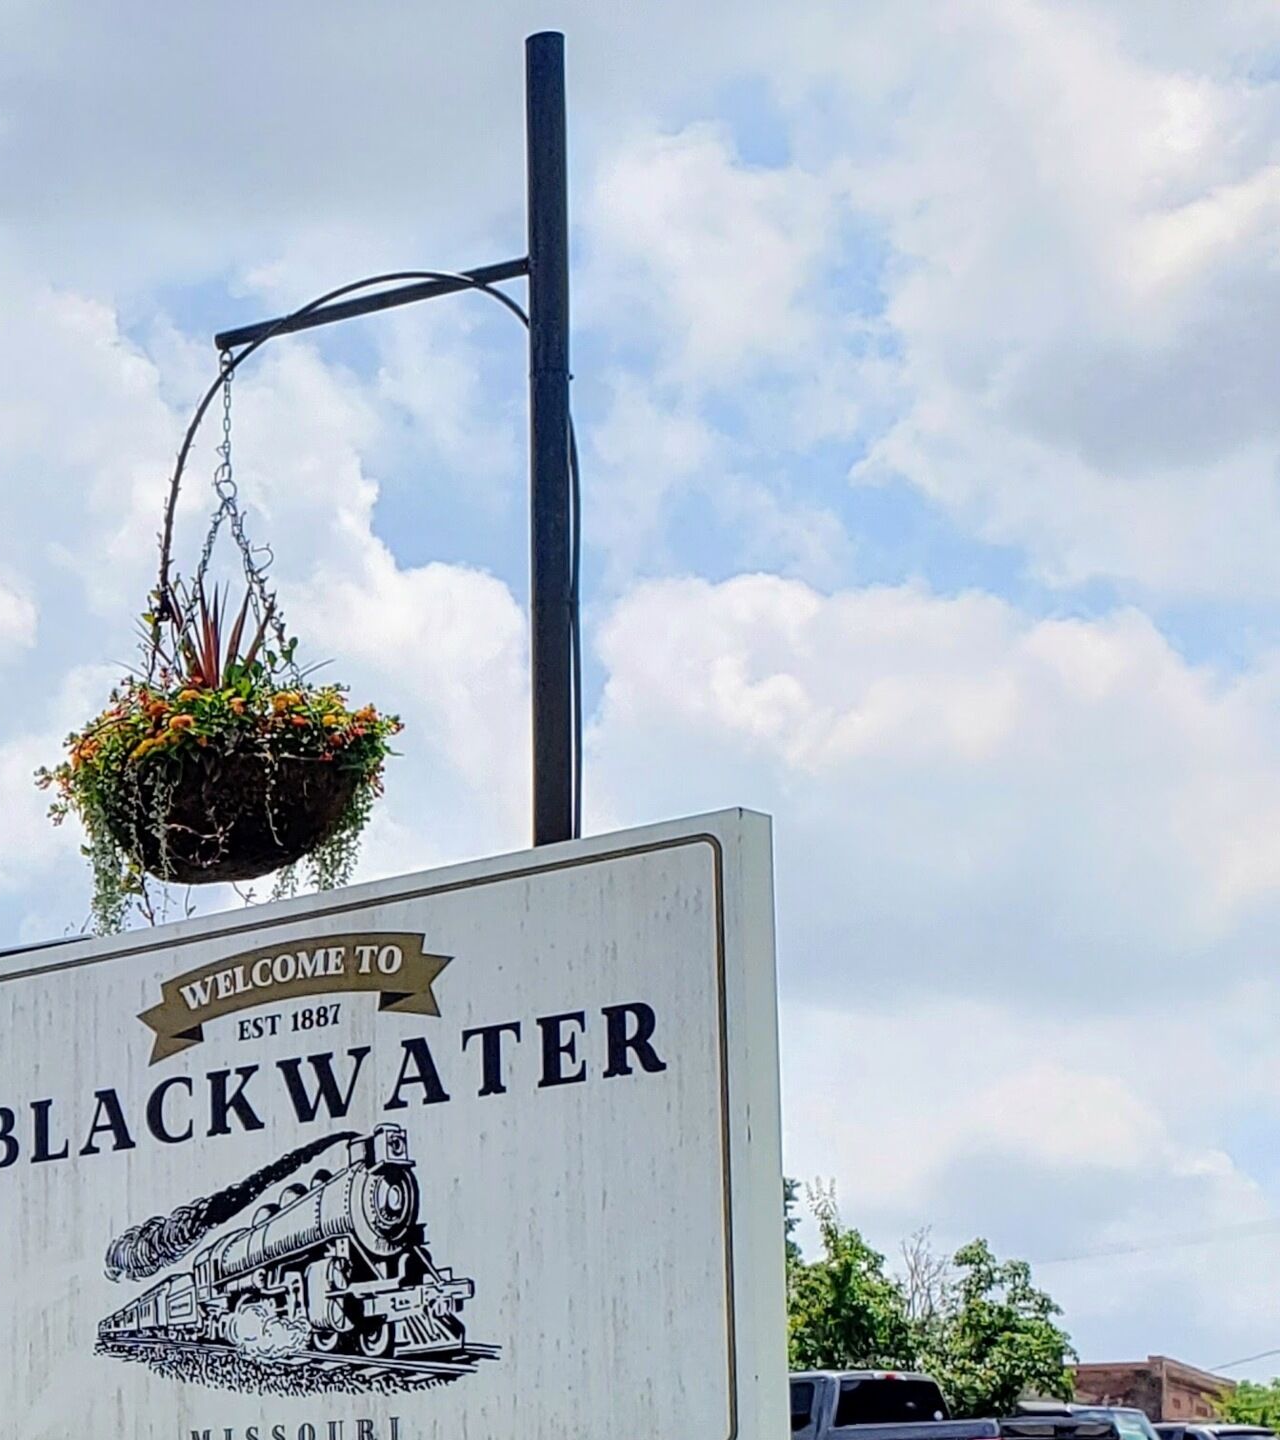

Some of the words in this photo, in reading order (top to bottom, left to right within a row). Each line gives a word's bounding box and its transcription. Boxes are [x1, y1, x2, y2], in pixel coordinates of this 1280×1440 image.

[179, 946, 345, 1011] WELCOME
[355, 944, 403, 974] TO
[238, 1013, 282, 1041] EST
[291, 1003, 342, 1032] 1887
